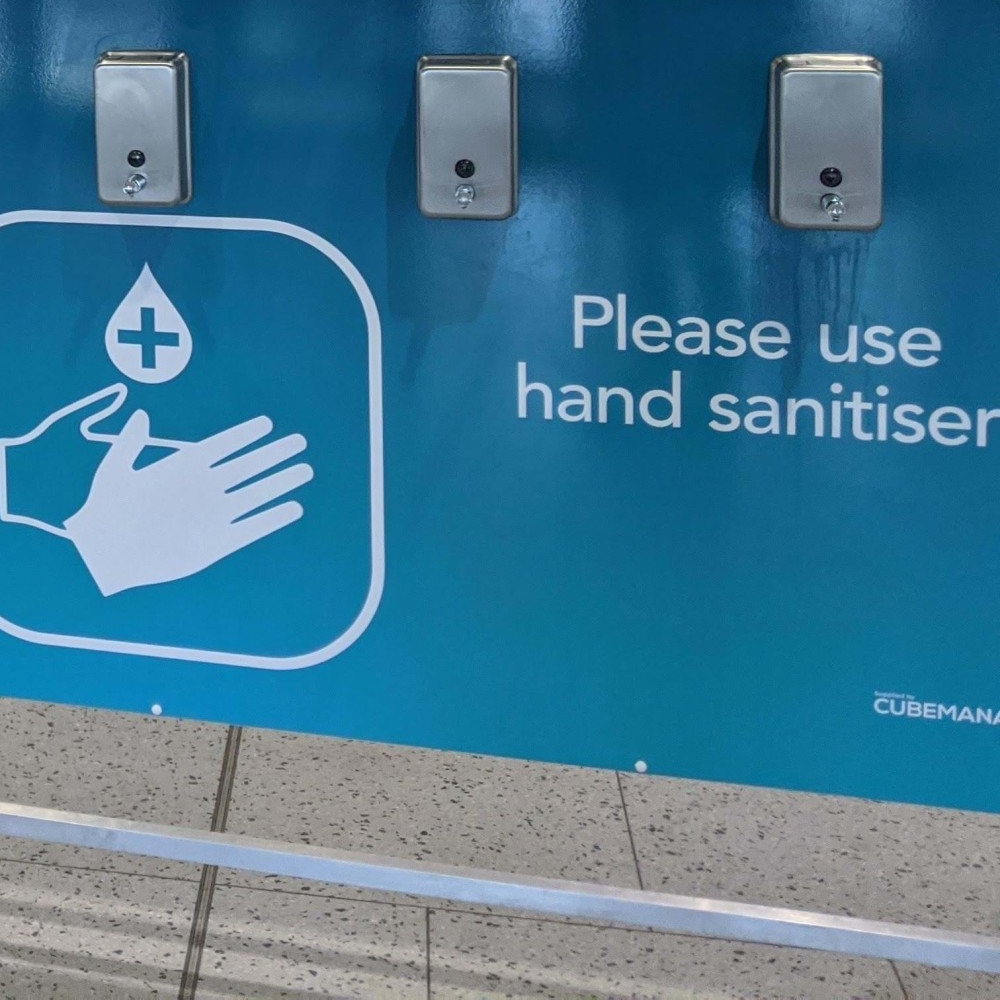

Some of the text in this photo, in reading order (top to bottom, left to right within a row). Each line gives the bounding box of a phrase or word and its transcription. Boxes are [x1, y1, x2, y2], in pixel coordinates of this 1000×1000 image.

[573, 293, 942, 368] Please use
[516, 361, 1000, 448] hand sanitiser
